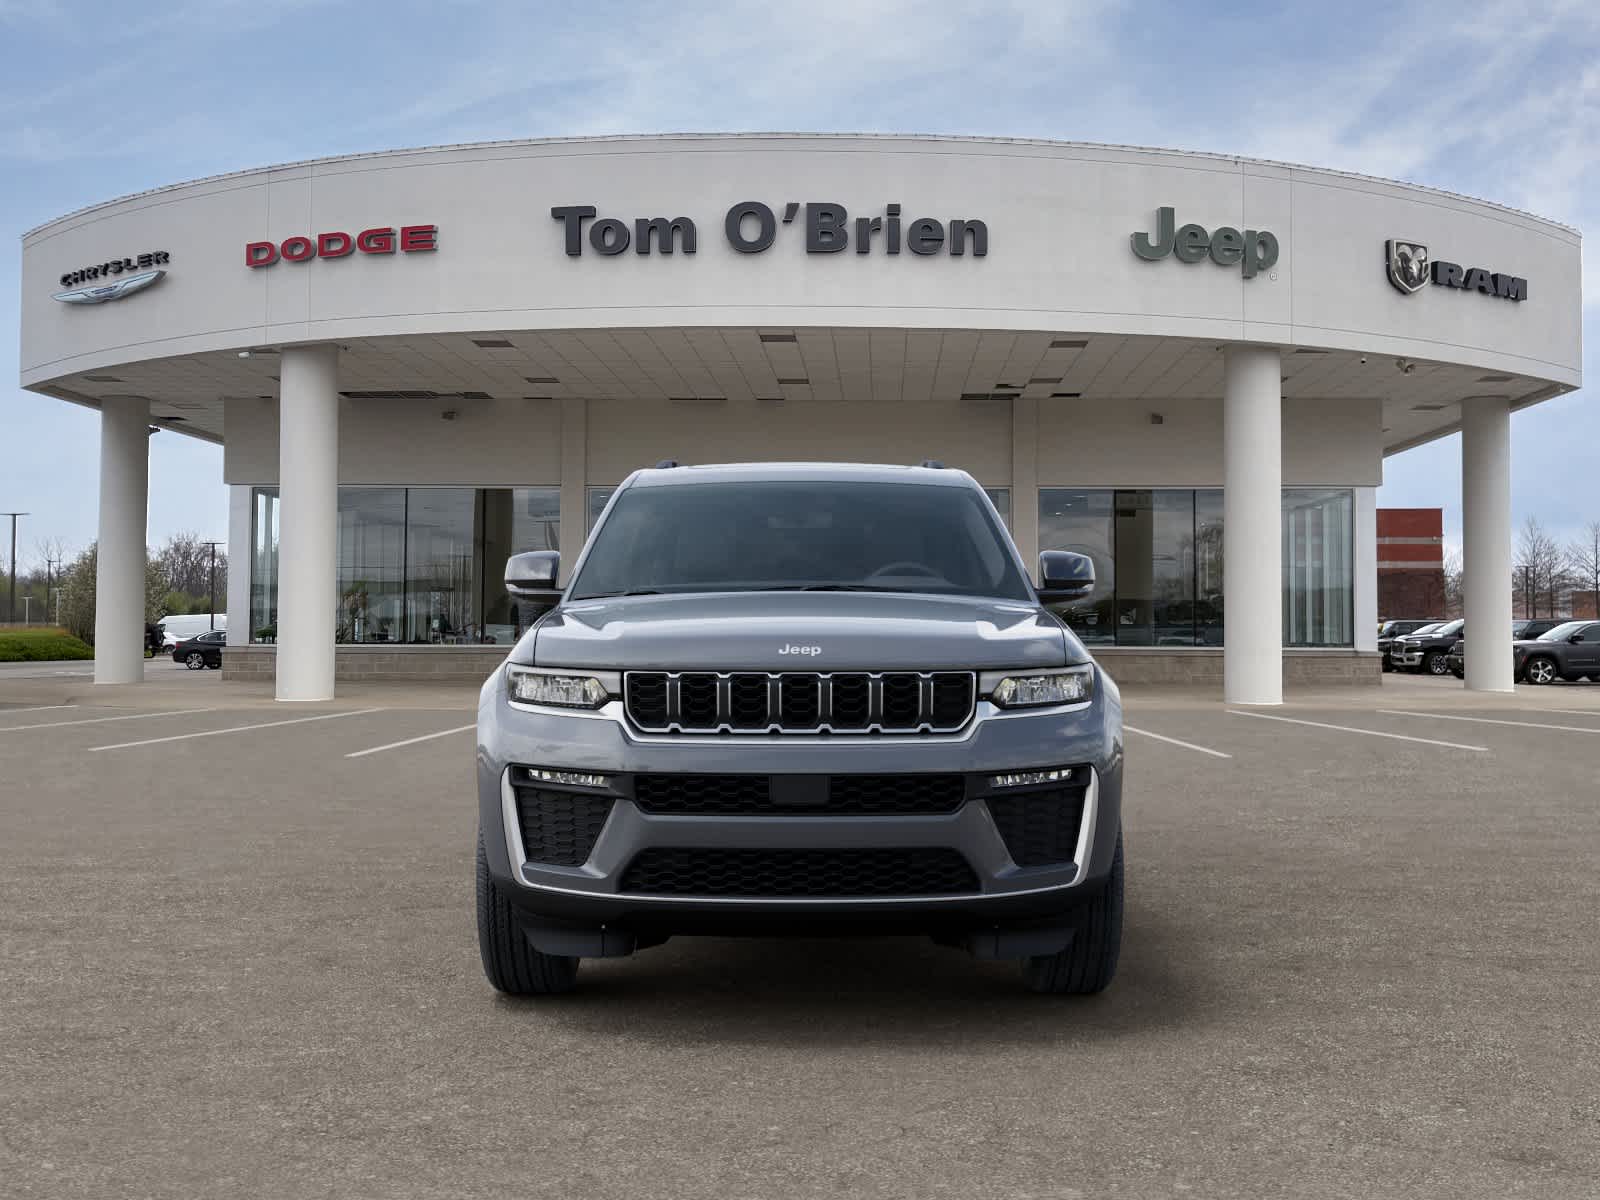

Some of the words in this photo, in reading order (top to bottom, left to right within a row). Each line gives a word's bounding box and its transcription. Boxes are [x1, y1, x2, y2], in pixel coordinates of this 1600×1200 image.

[246, 224, 438, 269] DODGE
[551, 205, 696, 256] Tom
[725, 201, 988, 256] O'Brien
[1130, 206, 1279, 279] Jeep
[60, 250, 169, 287] CHRYSLER
[1431, 261, 1528, 301] RAM
[778, 643, 822, 657] Jeep
